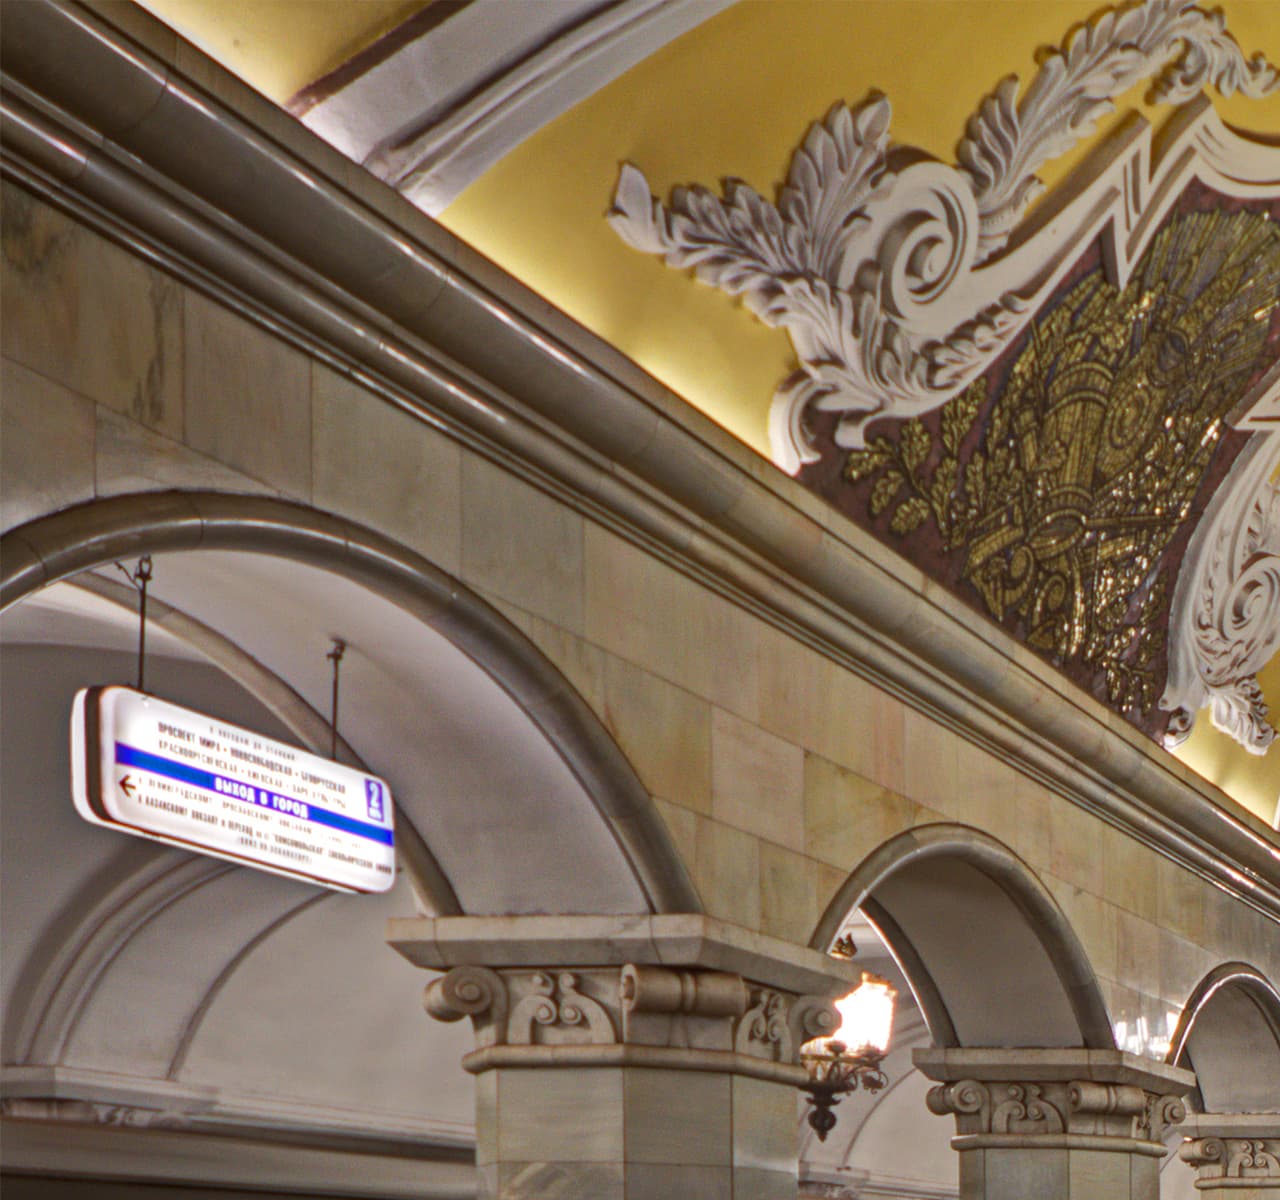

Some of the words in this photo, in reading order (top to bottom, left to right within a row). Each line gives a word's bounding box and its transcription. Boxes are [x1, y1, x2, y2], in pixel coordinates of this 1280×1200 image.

[215, 777, 255, 803] ВЫХОД
[260, 791, 267, 806] В
[273, 795, 309, 819] ГОРОД
[368, 783, 380, 809] 2
